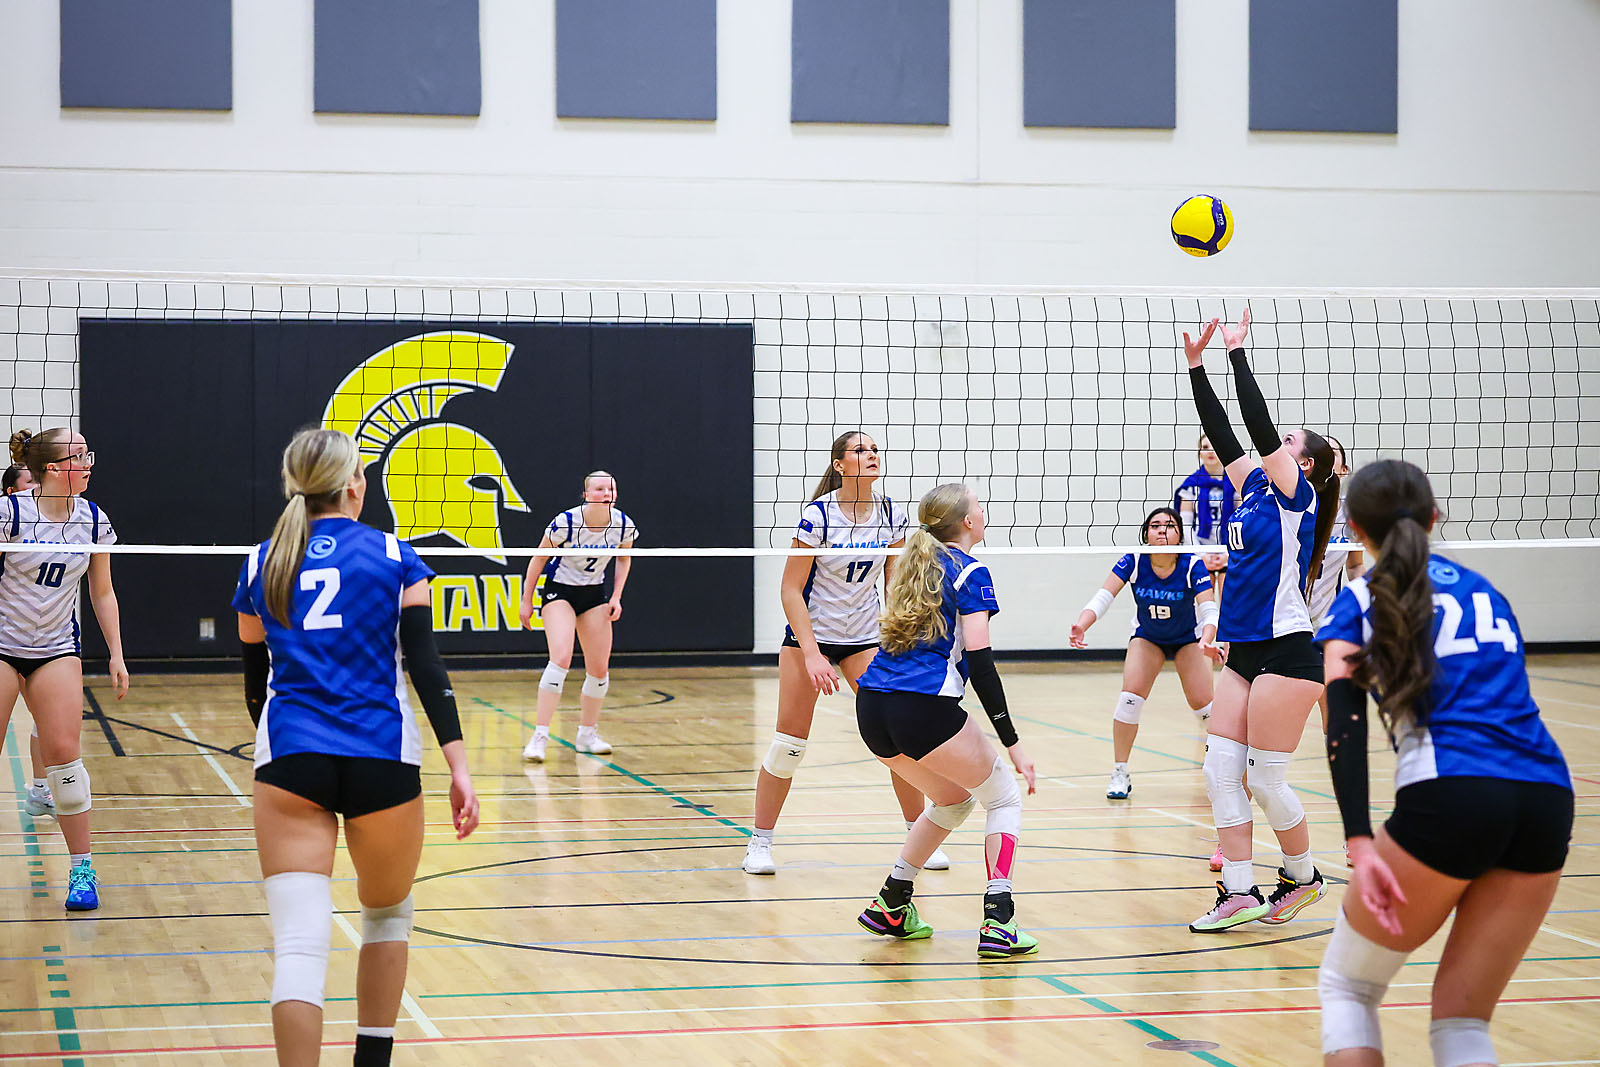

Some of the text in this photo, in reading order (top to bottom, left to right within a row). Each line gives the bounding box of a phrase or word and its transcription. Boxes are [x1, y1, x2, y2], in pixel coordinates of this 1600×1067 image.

[1227, 522, 1244, 550] 10
[35, 562, 67, 587] 10
[584, 558, 598, 572] 2
[846, 561, 873, 583] 17
[300, 567, 343, 631] 2
[1136, 587, 1184, 601] HAWKS
[1148, 605, 1171, 619] 19
[1431, 592, 1518, 659] 24
